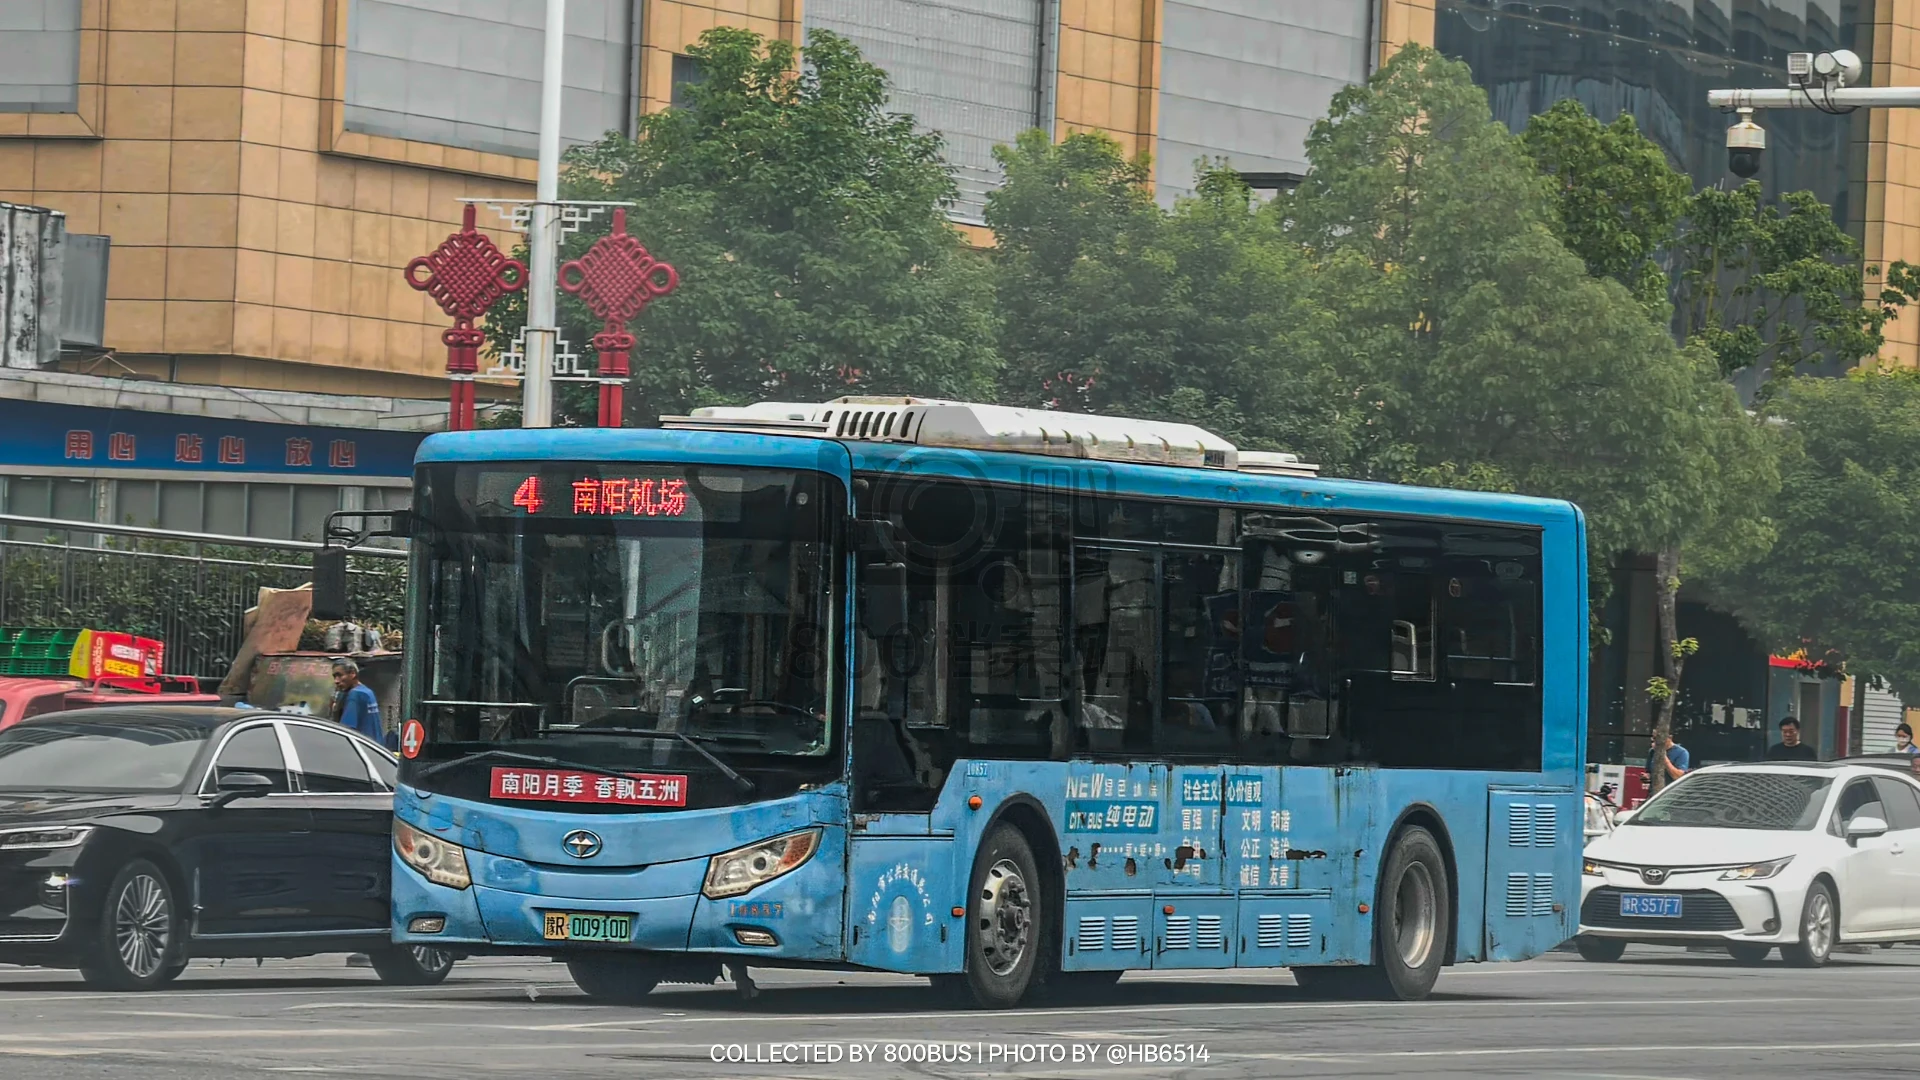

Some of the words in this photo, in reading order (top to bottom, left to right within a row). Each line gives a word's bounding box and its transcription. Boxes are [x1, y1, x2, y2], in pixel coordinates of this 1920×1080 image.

[65, 430, 135, 460] 用心
[175, 434, 245, 464] 贴心
[286, 437, 355, 467] 放心
[513, 476, 542, 513] 4
[572, 478, 687, 516] 南阳机场
[403, 722, 418, 753] 4
[501, 772, 584, 797] 南阳月季
[595, 778, 679, 802] 香飘五洲
[1065, 773, 1104, 798] NEW
[1183, 780, 1262, 802] 社会主义心价值观
[1087, 811, 1104, 829] BUS
[1104, 804, 1154, 828] 纯电动
[1242, 809, 1261, 831] 文明
[1241, 838, 1261, 858] 公正
